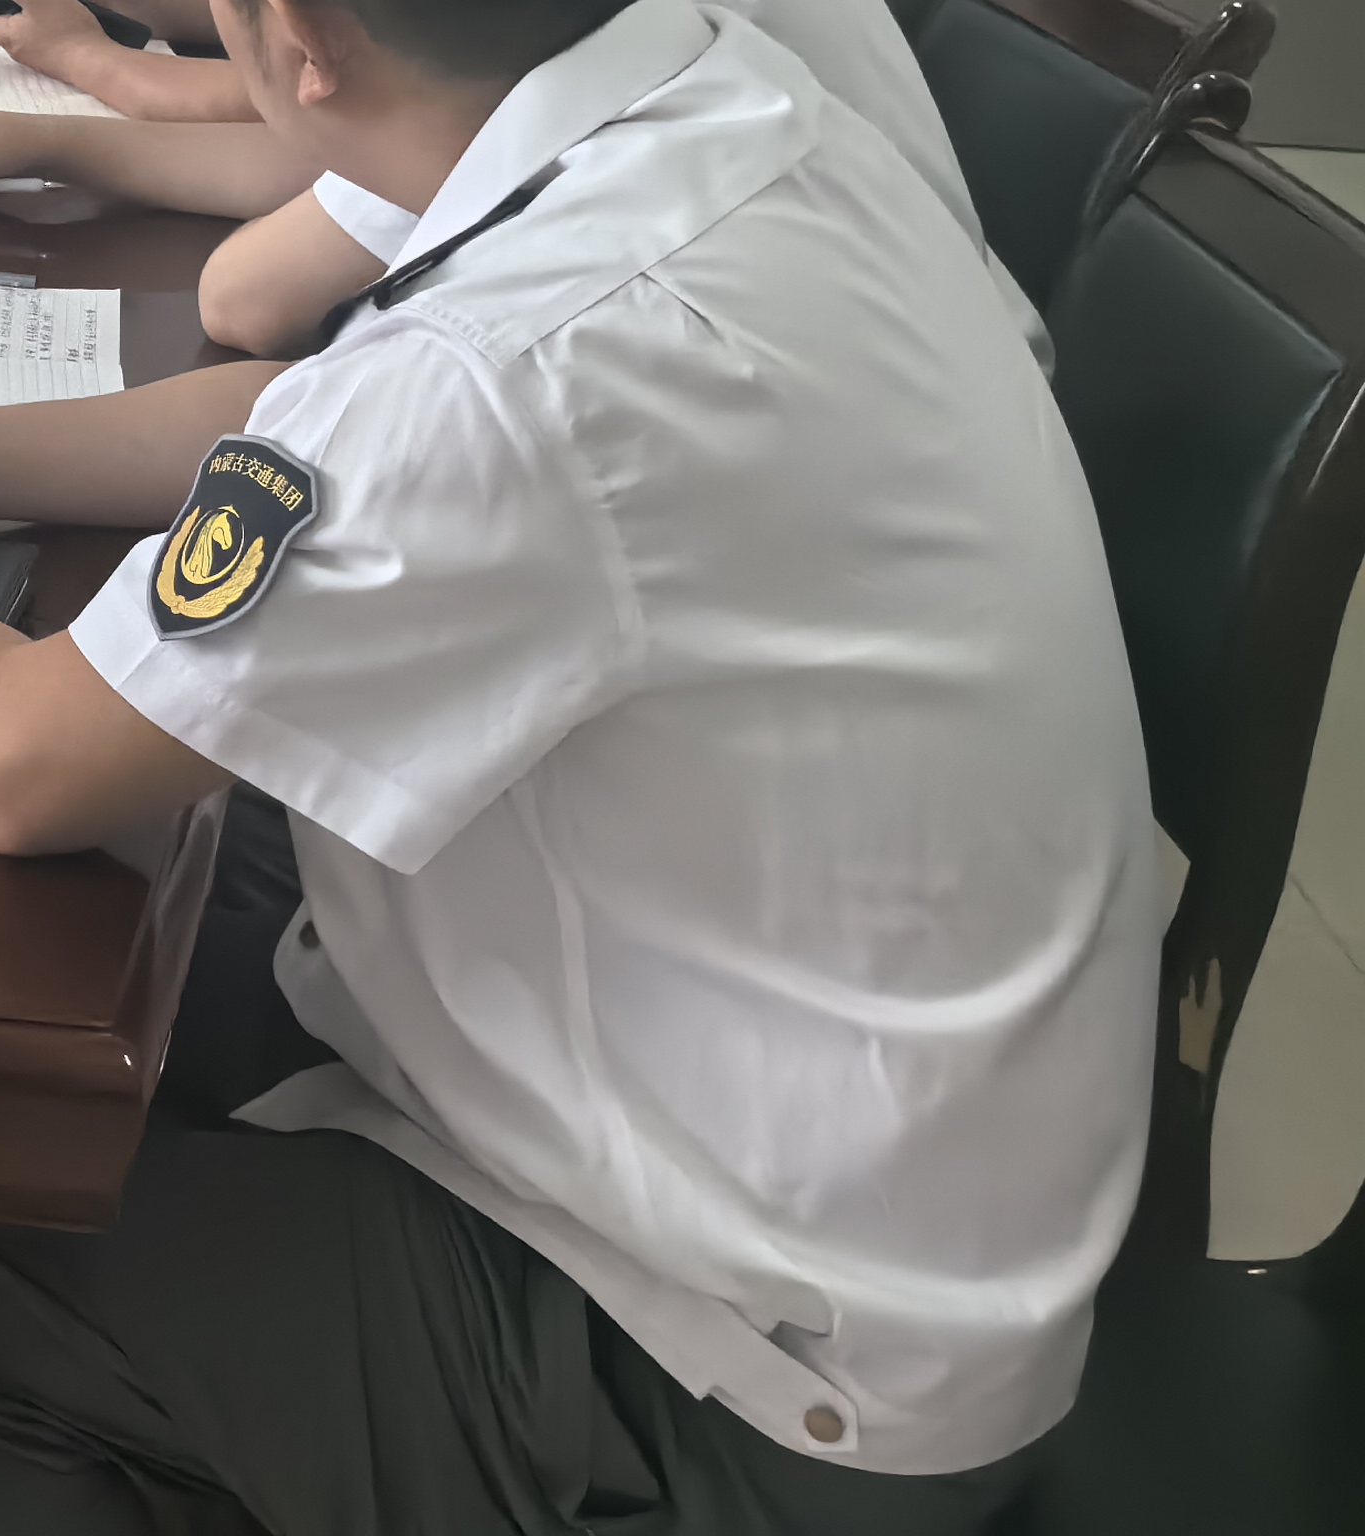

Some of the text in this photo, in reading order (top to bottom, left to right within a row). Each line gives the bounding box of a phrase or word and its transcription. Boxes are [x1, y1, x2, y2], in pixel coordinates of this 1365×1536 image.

[208, 452, 305, 512] 内蒙古交通集团
